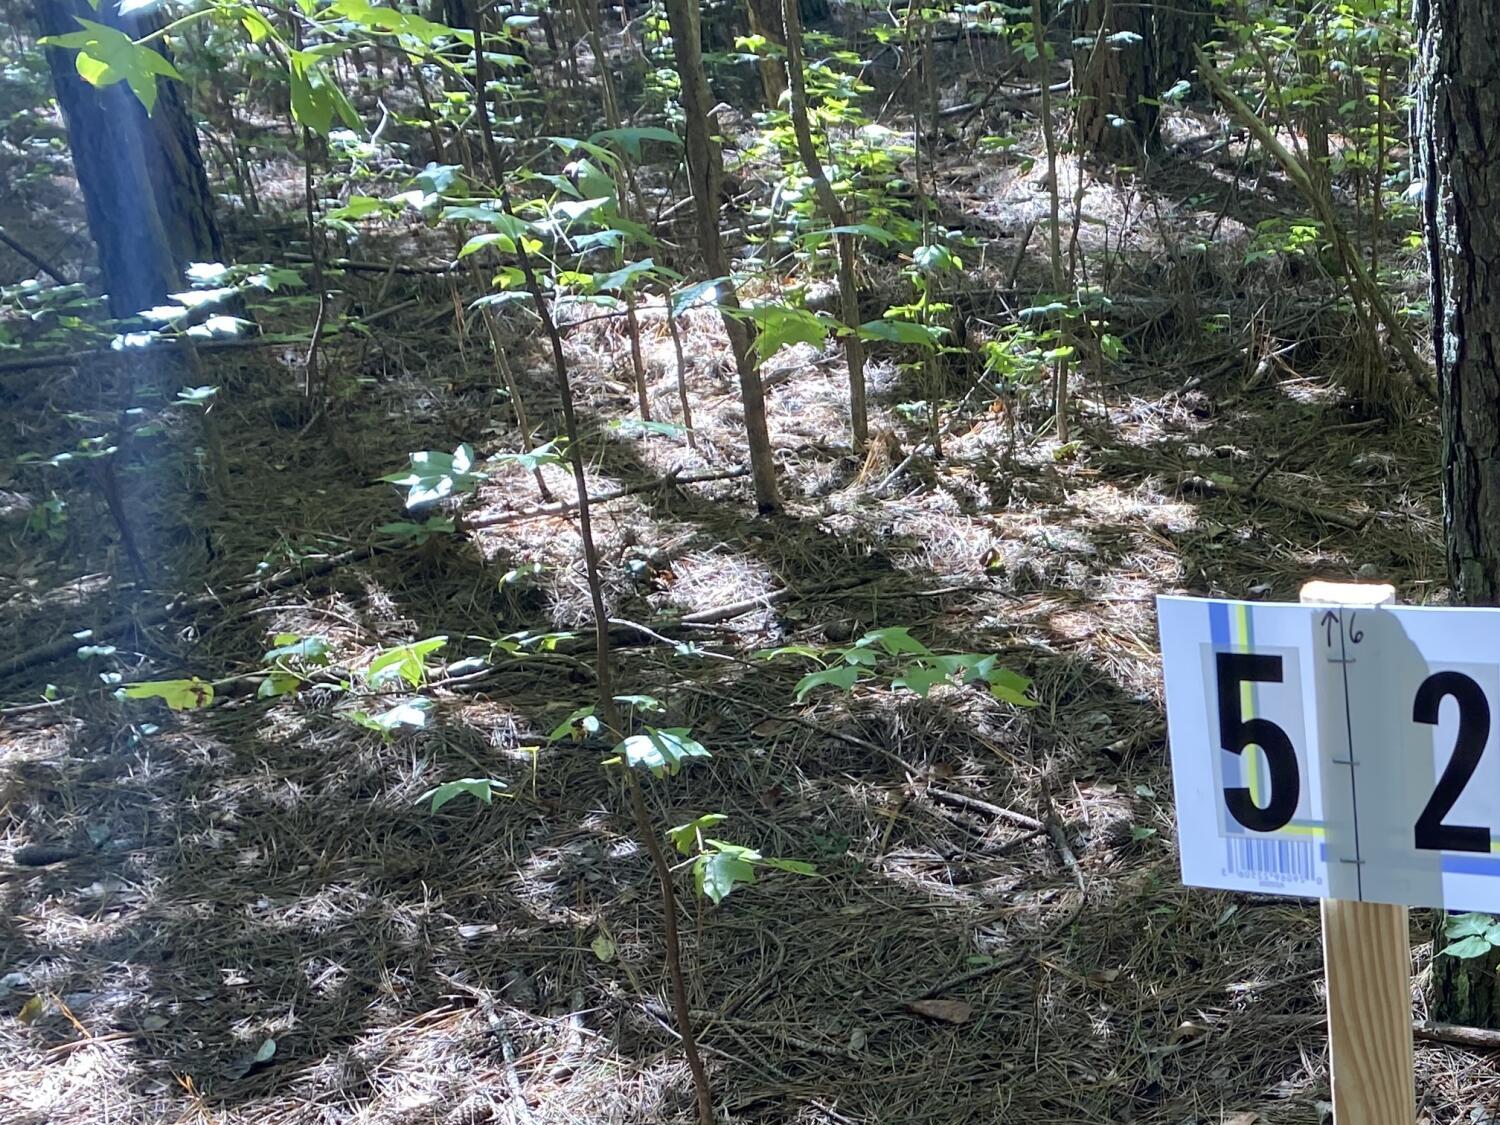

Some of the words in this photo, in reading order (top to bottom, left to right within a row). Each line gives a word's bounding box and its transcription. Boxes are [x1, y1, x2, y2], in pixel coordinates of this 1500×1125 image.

[1349, 612, 1364, 643] 6
[1216, 652, 1300, 832] 5
[1413, 671, 1491, 853] 2
